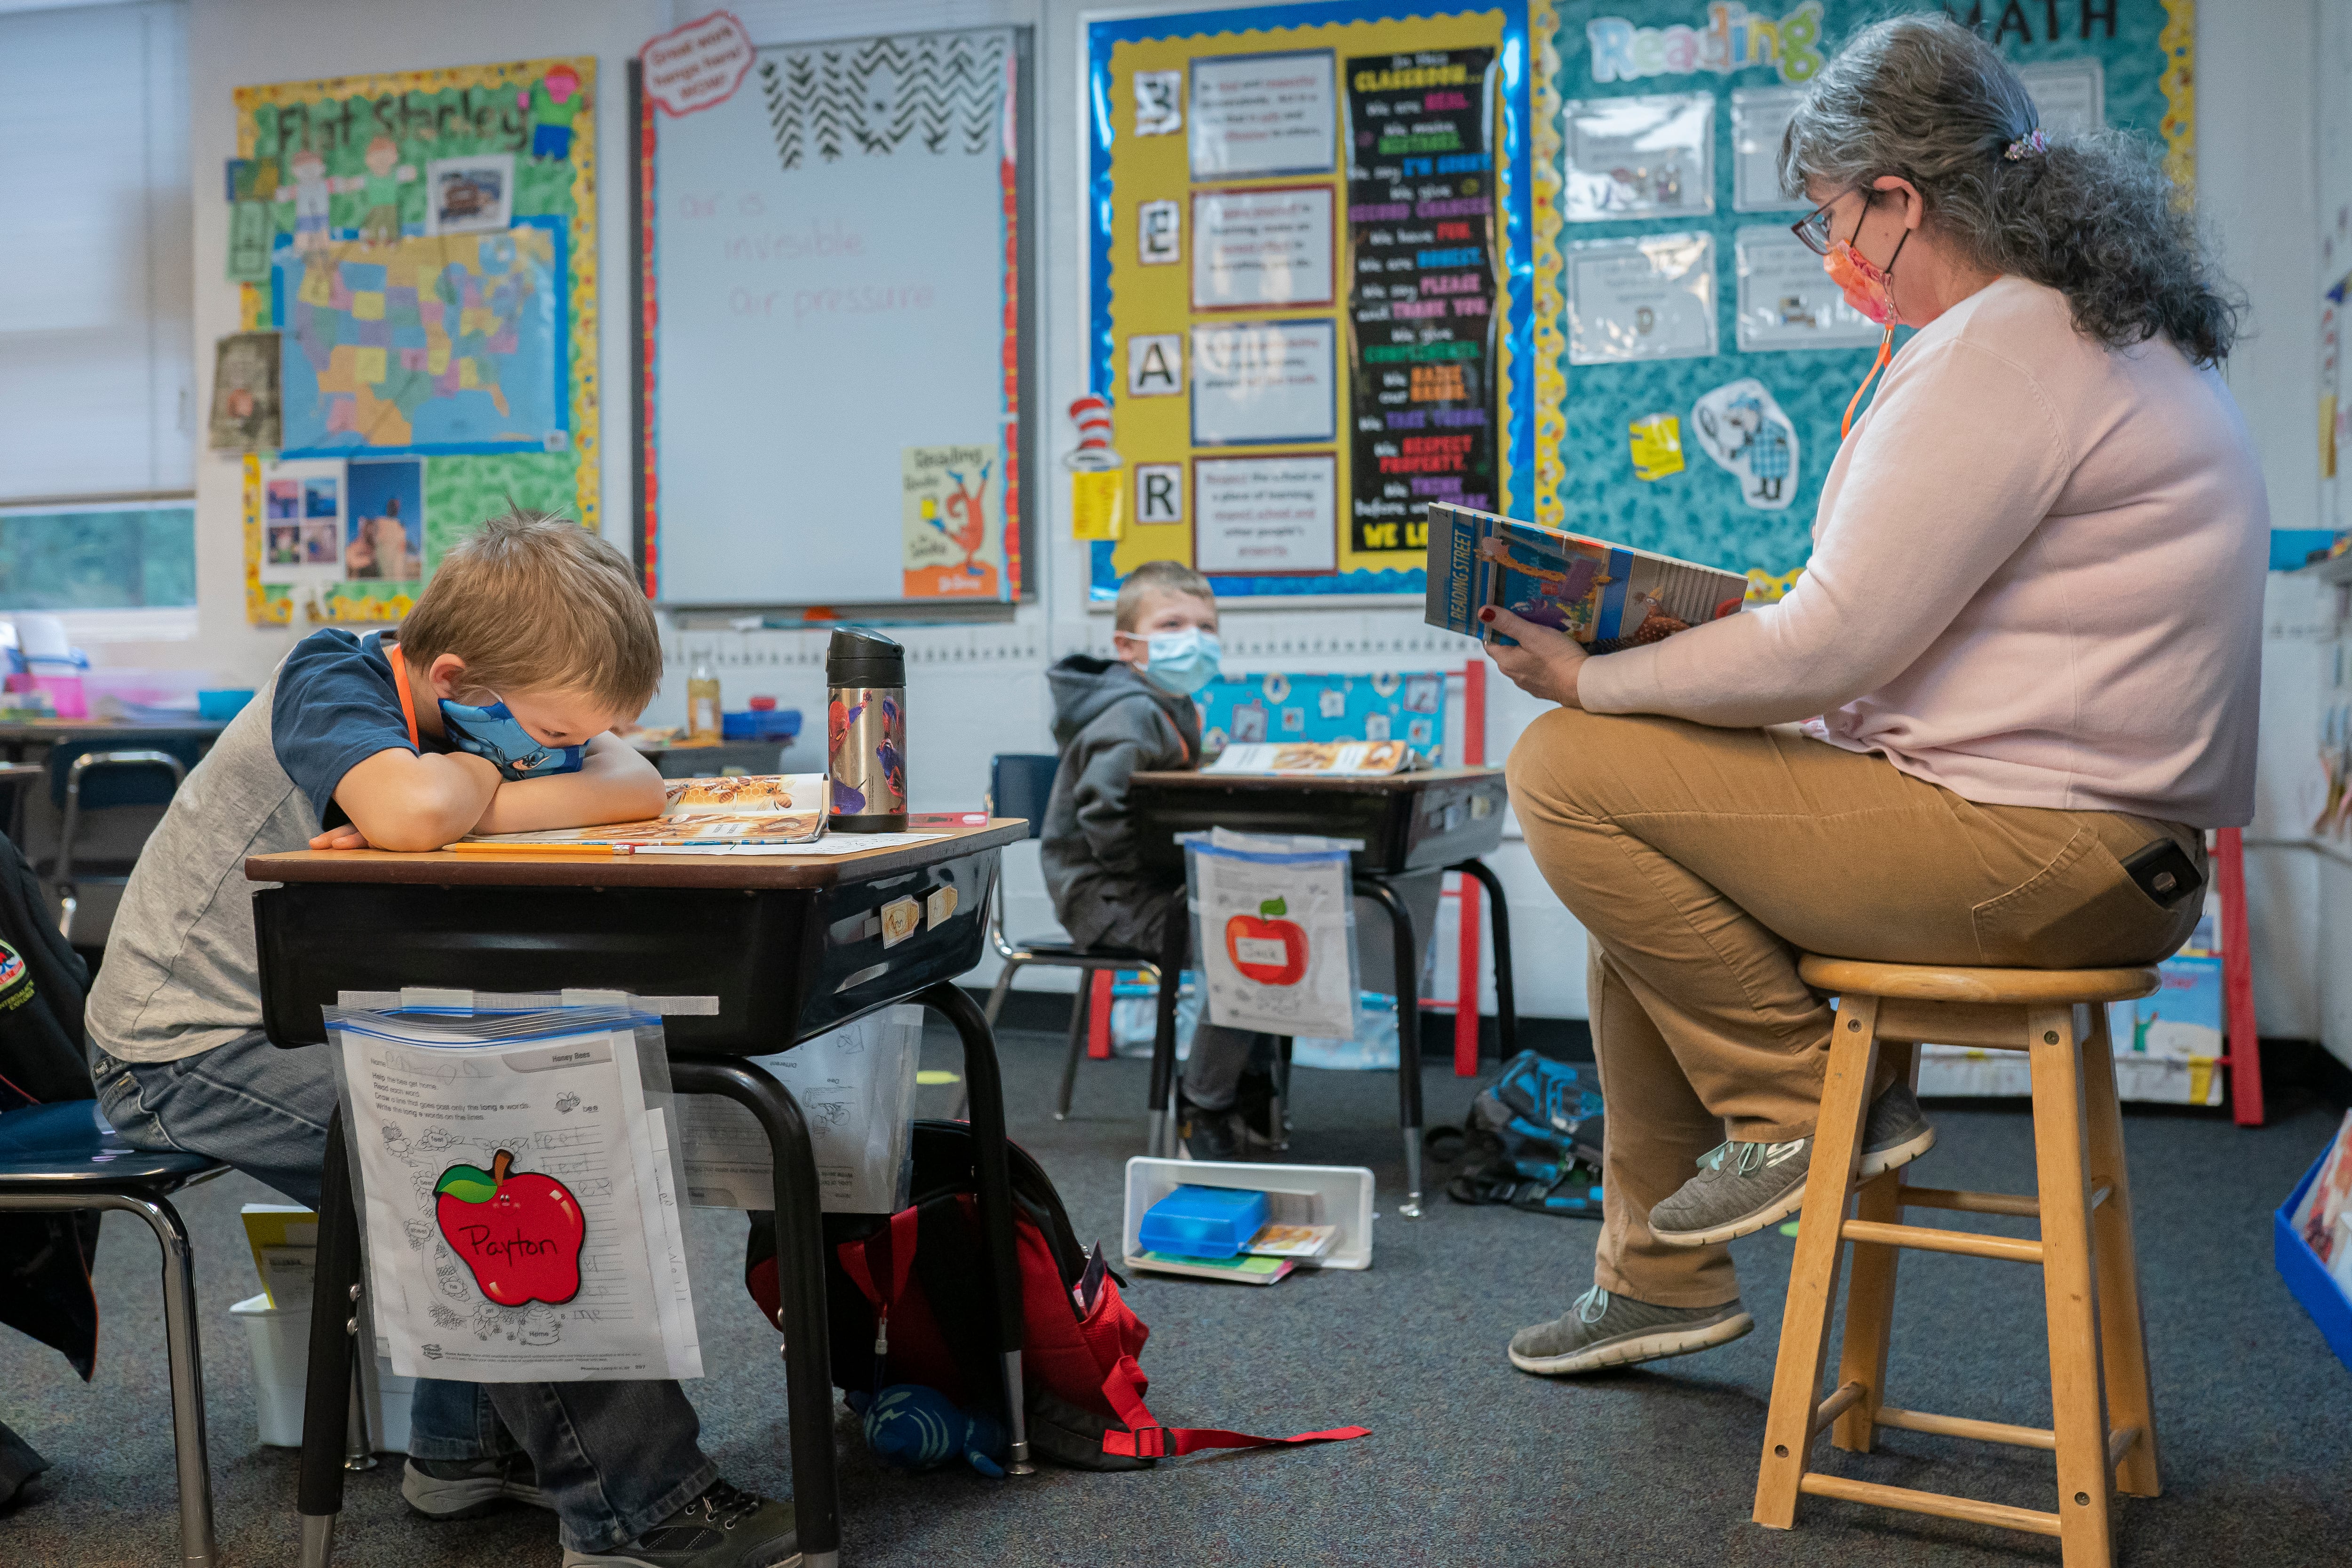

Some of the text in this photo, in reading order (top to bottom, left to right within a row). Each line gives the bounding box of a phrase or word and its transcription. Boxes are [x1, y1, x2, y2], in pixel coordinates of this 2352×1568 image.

[652, 26, 732, 65] Great work
[1588, 2, 1821, 83] Reading
[653, 64, 699, 87] hangs
[1366, 100, 1390, 116] We
[1394, 100, 1421, 114] are
[278, 97, 351, 151] Flat
[1383, 120, 1456, 135] We make
[1373, 166, 1402, 184] say
[1390, 183, 1453, 202] We give
[680, 191, 765, 218] air is
[725, 218, 866, 261] invisible
[1146, 207, 1171, 255] E
[1369, 230, 1394, 246] We
[1397, 228, 1434, 243] have
[1358, 257, 1383, 273] We
[1386, 257, 1414, 271] are
[1362, 274, 1481, 303] We say PLEASE
[729, 285, 936, 322] air pressure
[1391, 328, 1454, 346] We give
[1137, 342, 1174, 387] A
[1383, 371, 1408, 388] We
[1378, 390, 1408, 405] our
[1359, 415, 1383, 432] We
[1374, 435, 1473, 458] We RESPECT
[1379, 453, 1469, 474] PROPERTY.
[1145, 473, 1174, 517] R
[1383, 482, 1409, 499] We
[1354, 497, 1407, 517] before
[1364, 523, 1398, 548] WE
[1450, 528, 1471, 622] READING STREET
[370, 1057, 386, 1067] Name
[552, 1054, 573, 1063] Honey
[372, 1072, 386, 1082] Help
[386, 1075, 396, 1083] the
[373, 1082, 389, 1093] Read
[389, 1086, 404, 1094] each
[374, 1092, 390, 1102] Draw
[396, 1097, 406, 1106] line
[406, 1098, 419, 1107] that
[419, 1102, 435, 1110] goes
[436, 1103, 450, 1112] past
[451, 1104, 466, 1113] only
[480, 1104, 498, 1112] long
[375, 1102, 392, 1112] Write
[392, 1105, 402, 1114] the
[403, 1107, 418, 1118] long
[458, 1224, 558, 1267] Payton
